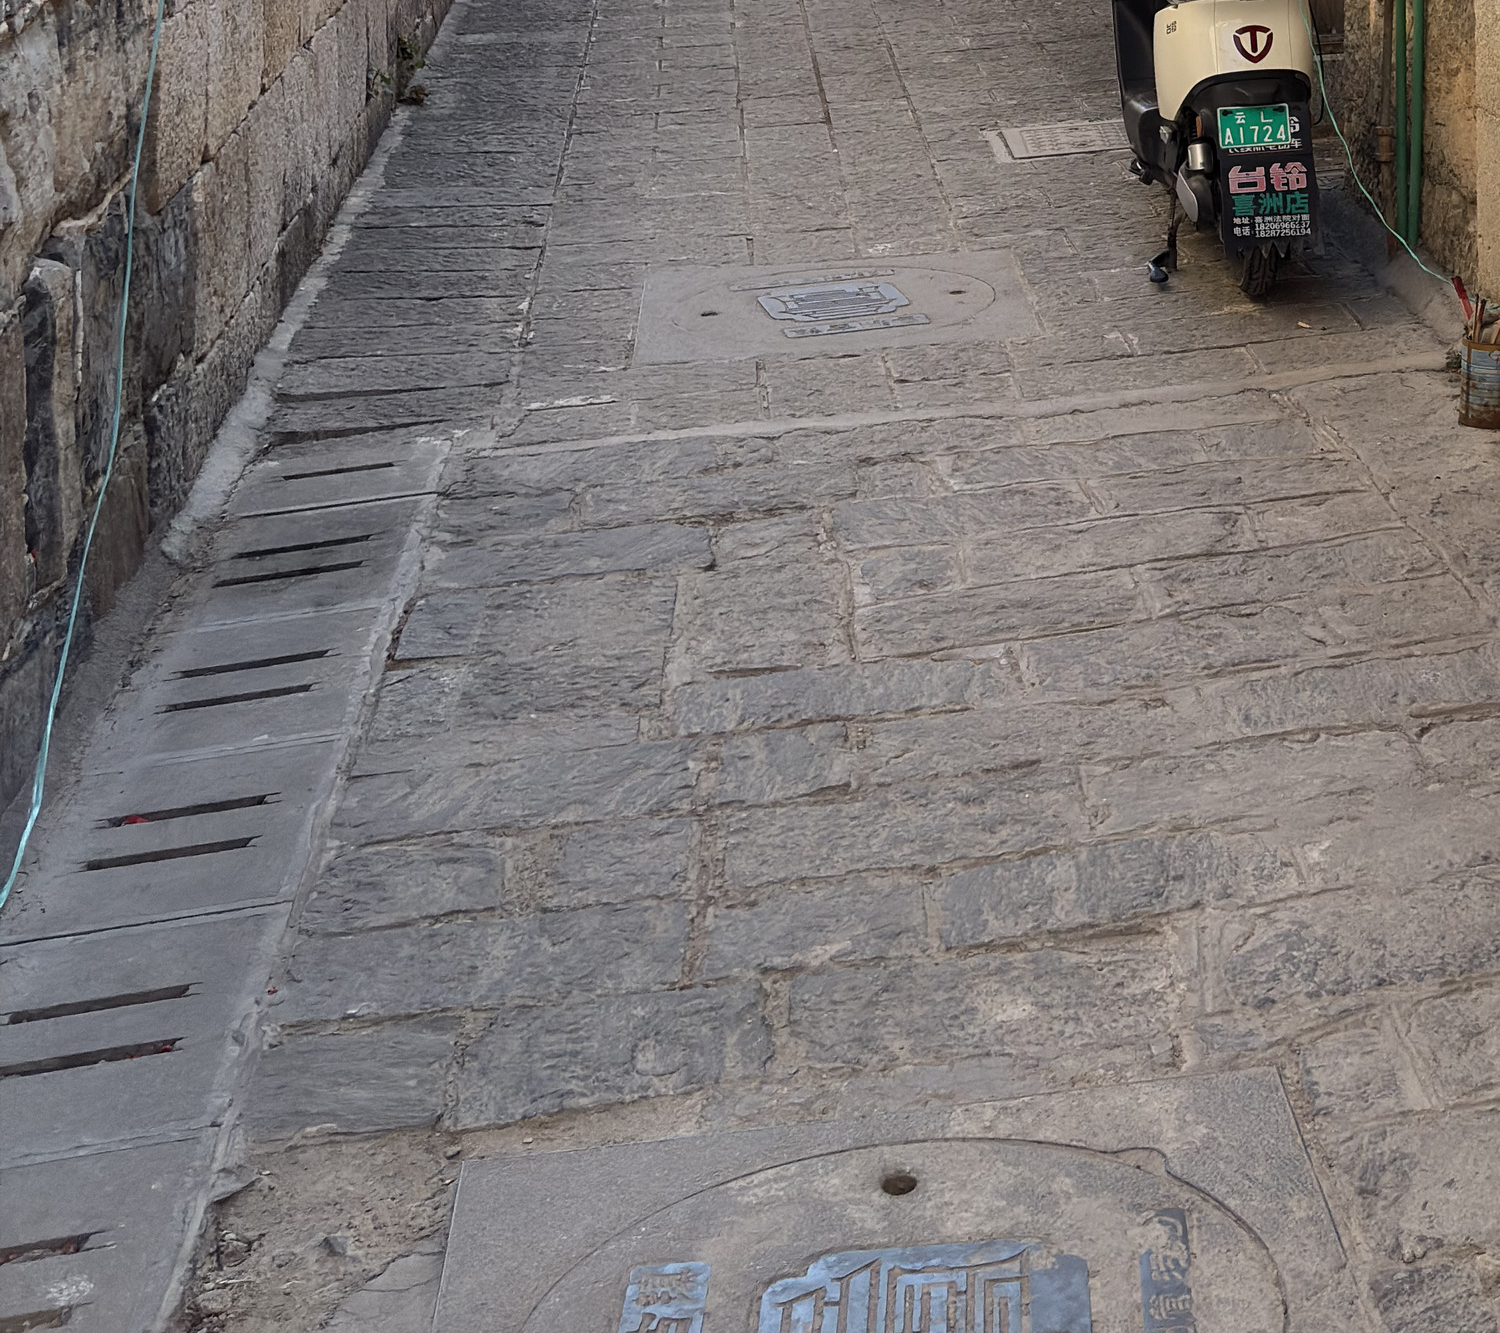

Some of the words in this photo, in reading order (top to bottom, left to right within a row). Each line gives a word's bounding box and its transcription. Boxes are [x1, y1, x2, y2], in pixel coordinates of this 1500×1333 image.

[1234, 112, 1246, 124] 云
[1261, 111, 1273, 123] L
[1224, 124, 1286, 145] A1724
[1228, 162, 1308, 194] 台铃
[1231, 192, 1310, 217] 喜洲店
